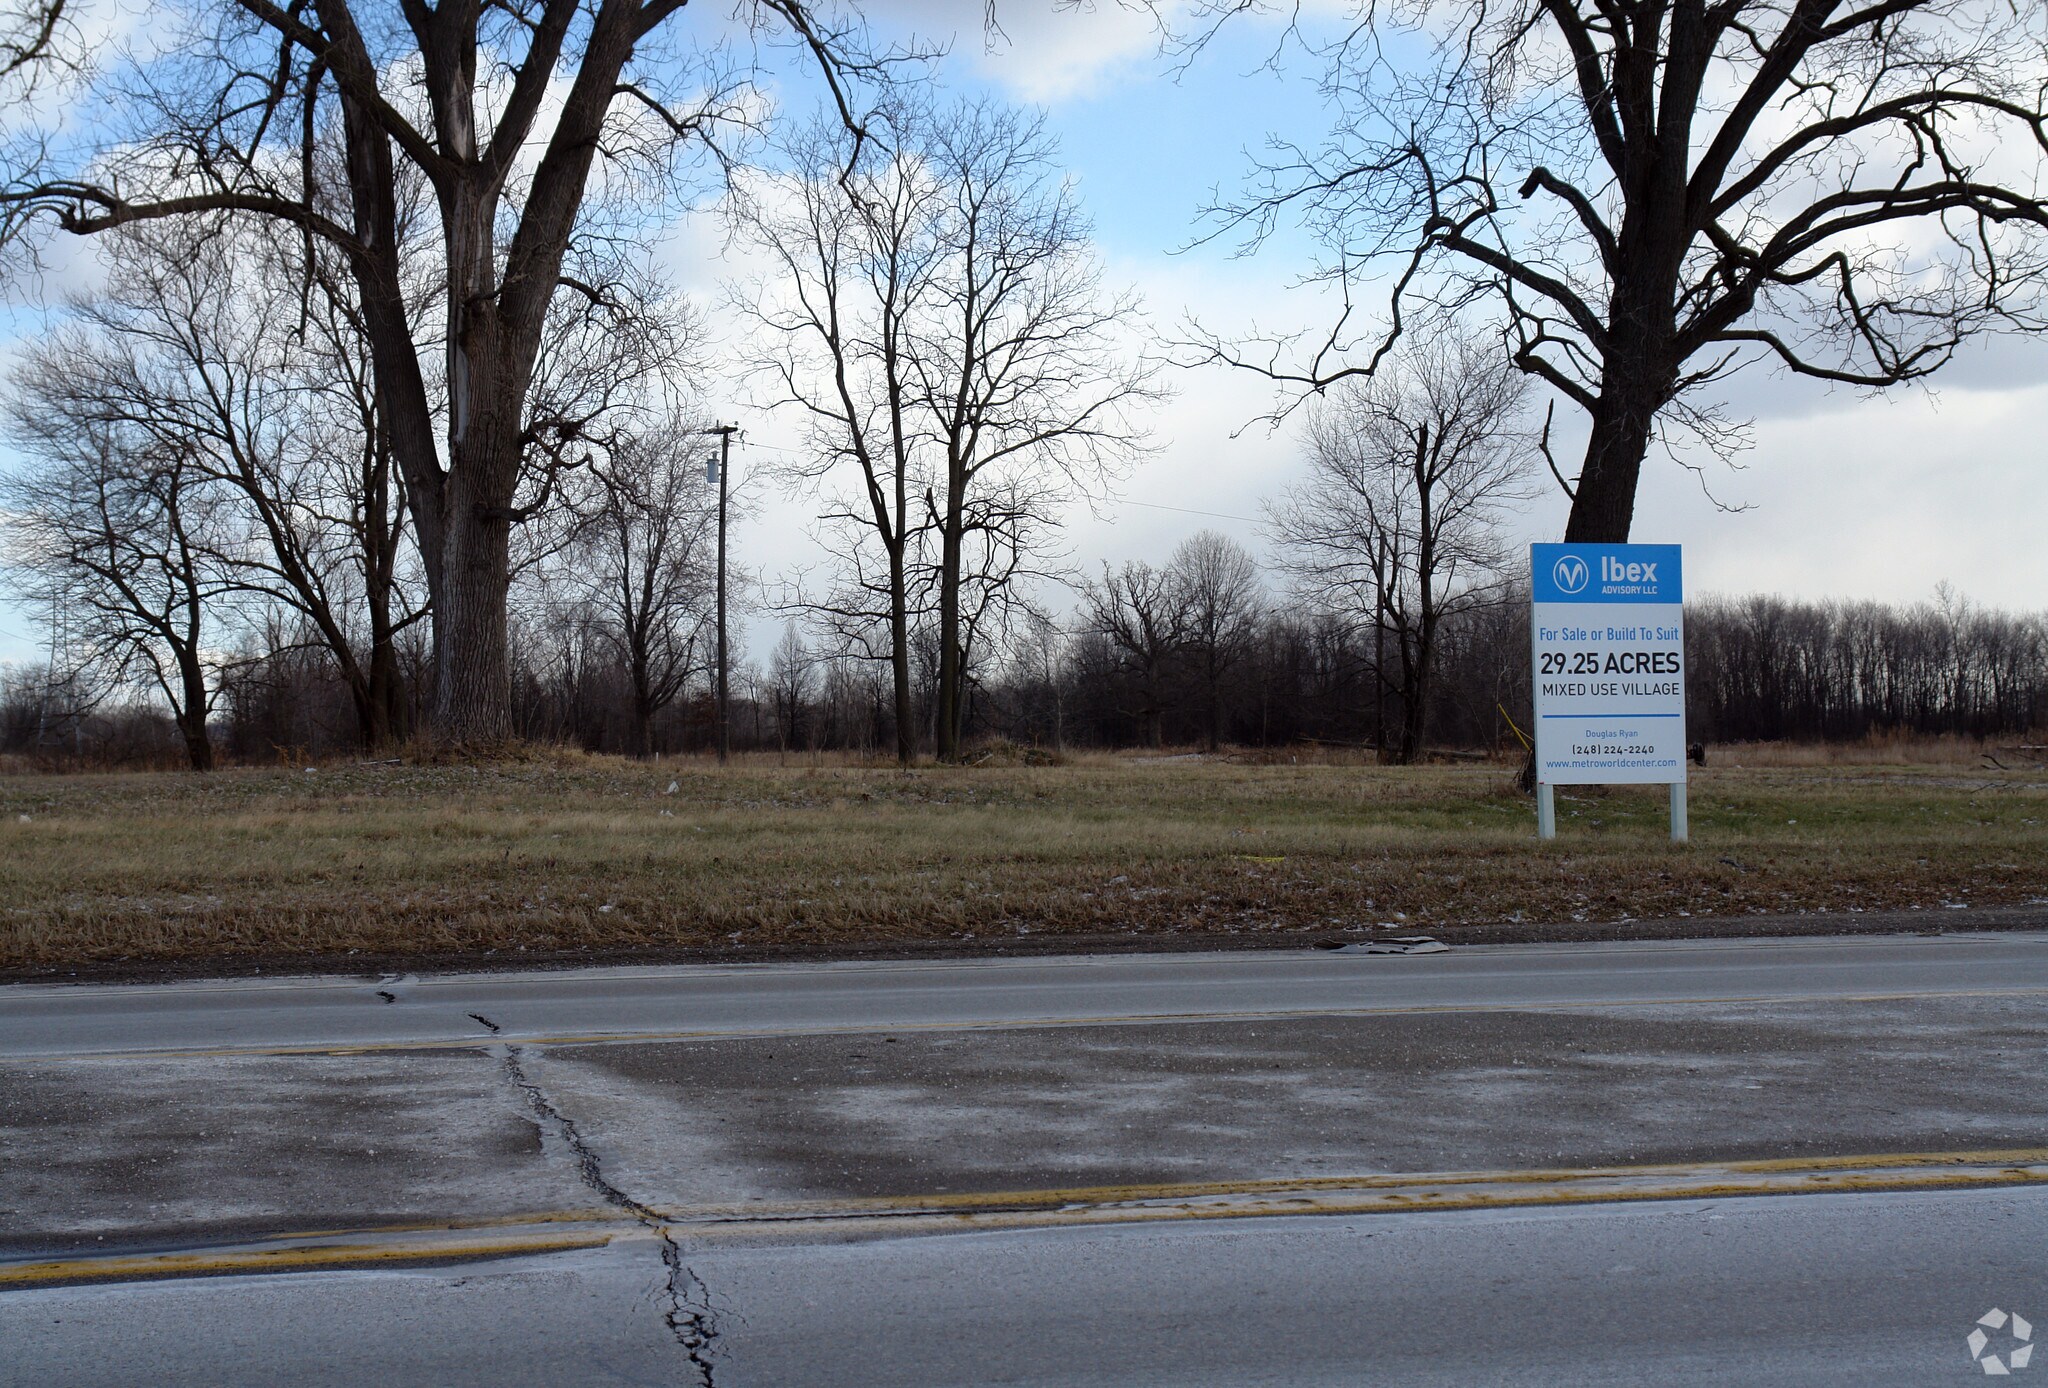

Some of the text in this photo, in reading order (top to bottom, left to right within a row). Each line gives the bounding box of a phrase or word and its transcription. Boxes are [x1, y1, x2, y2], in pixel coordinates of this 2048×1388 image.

[1601, 556, 1658, 582] Ibex
[1601, 585, 1658, 595] ADVISORY LLC
[1539, 626, 1679, 641] For Sale or Build To Suit
[1540, 652, 1681, 675] 29.25 ACRES
[1542, 682, 1680, 696] MIXED USE VILLAGE
[1585, 729, 1639, 739] Douglas Ryan
[1572, 744, 1655, 755] (248) 224-2240
[1546, 758, 1677, 768] www.metroworldcenter.com
